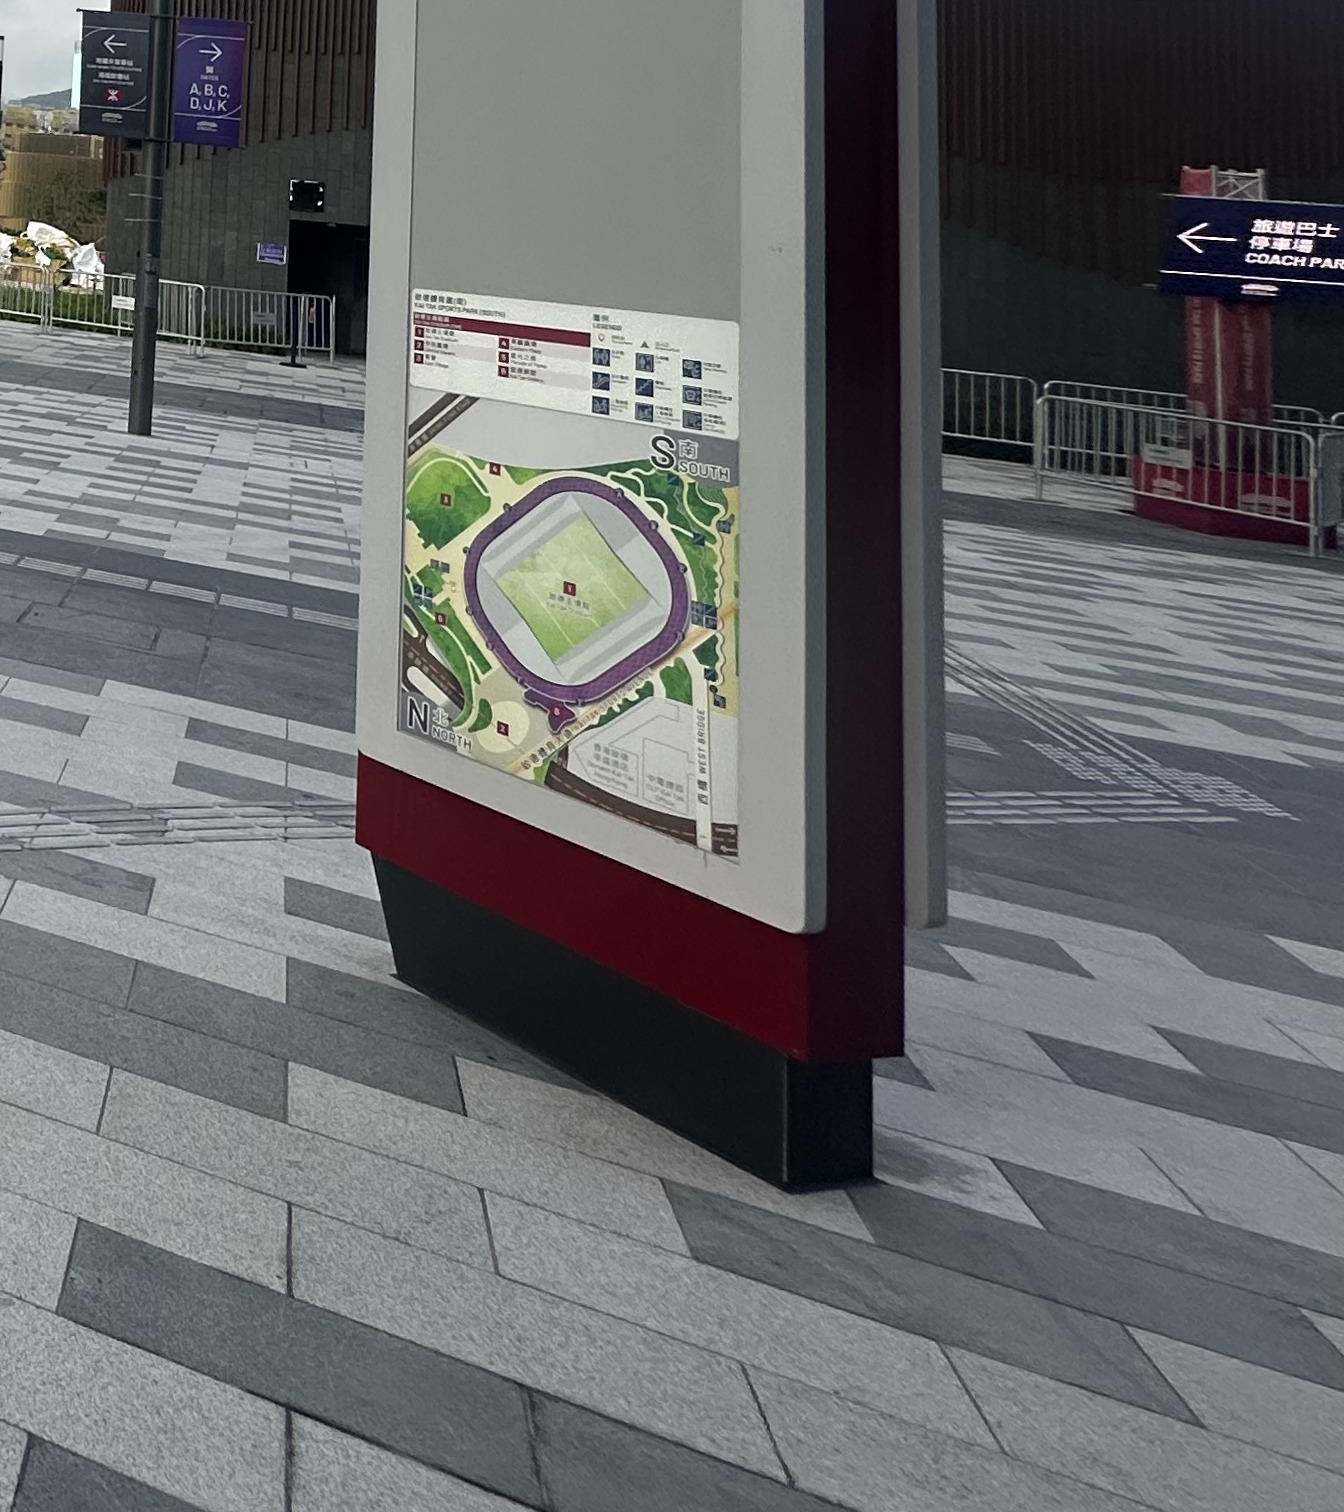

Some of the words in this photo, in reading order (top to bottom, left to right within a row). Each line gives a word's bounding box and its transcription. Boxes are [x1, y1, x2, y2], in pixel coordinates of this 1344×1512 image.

[217, 99, 227, 112] K
[1251, 219, 1340, 238] 旅遊巴士
[1245, 252, 1307, 266] COACH
[650, 435, 675, 469] S
[678, 460, 730, 483] SOUTH
[408, 696, 430, 734] N
[696, 709, 705, 744] BRIDGE
[432, 725, 473, 751] NORTH
[697, 748, 706, 774] WEST
